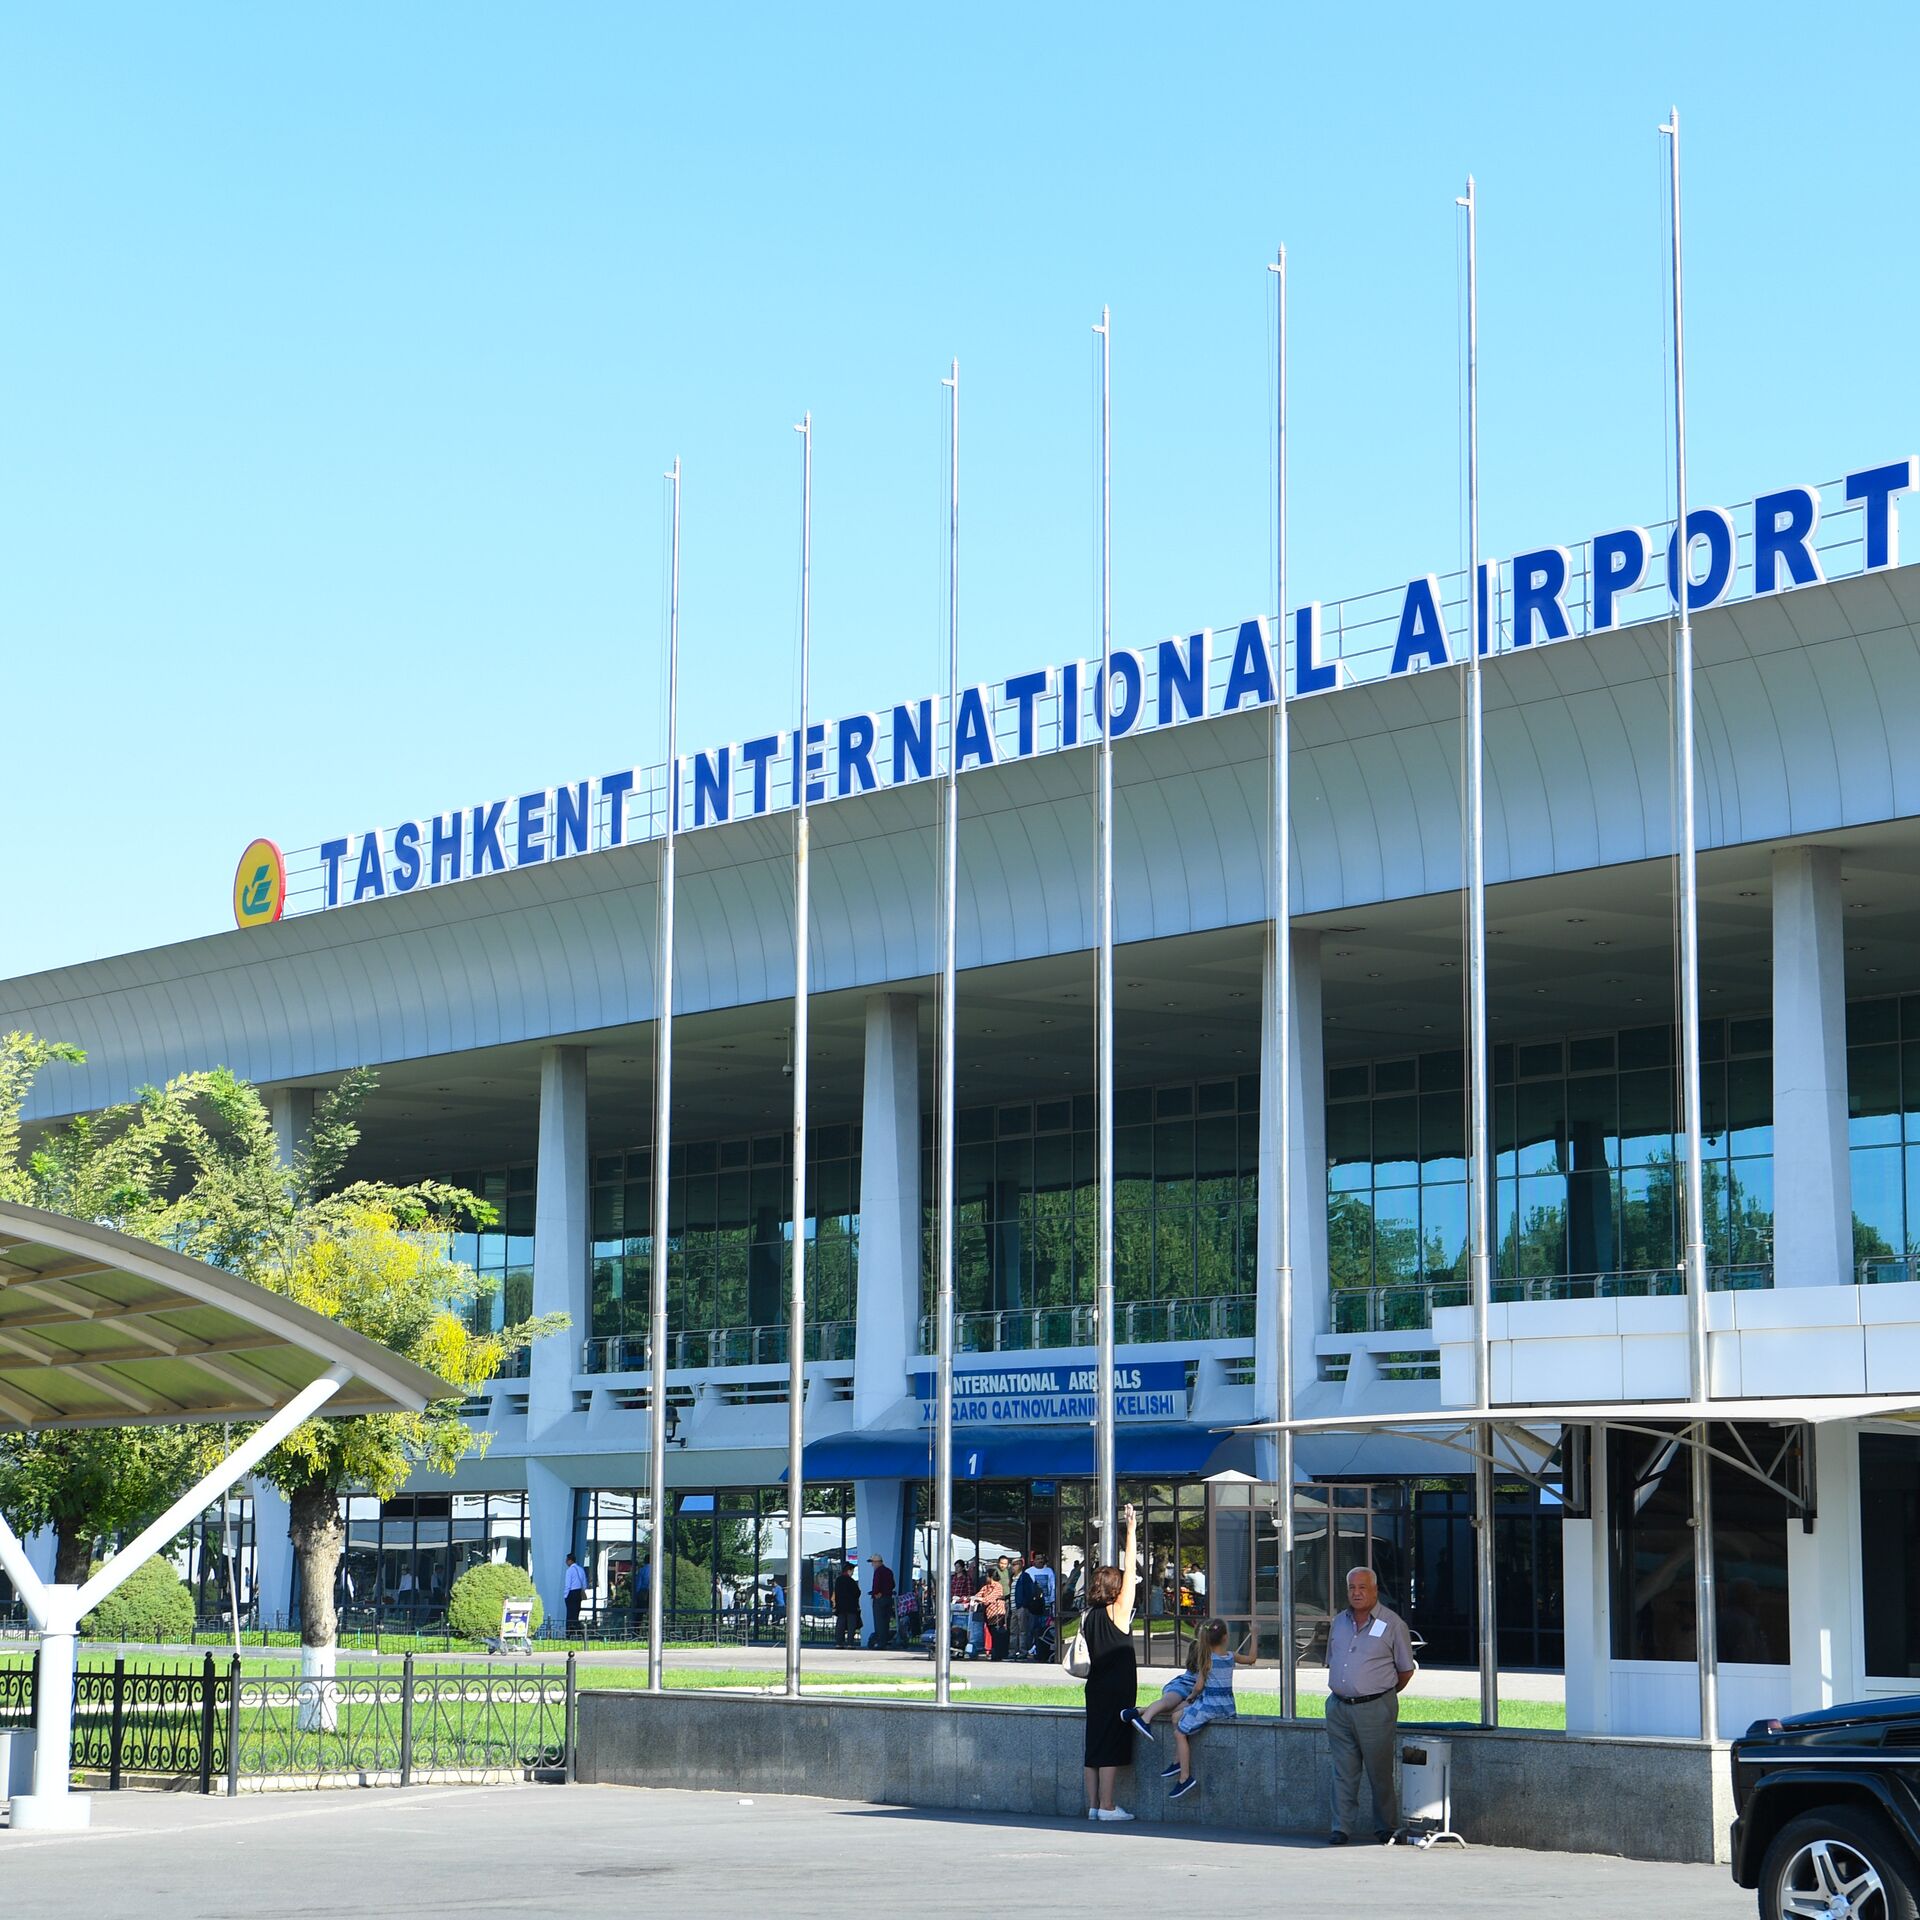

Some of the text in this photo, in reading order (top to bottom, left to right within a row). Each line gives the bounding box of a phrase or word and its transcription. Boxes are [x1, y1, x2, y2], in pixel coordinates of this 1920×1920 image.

[320, 769, 638, 908] TASHKENT
[1388, 458, 1915, 676] AIRPORT
[953, 1369, 1141, 1395] NTERNATIONAL ARRALS
[923, 1395, 1174, 1421] XQARO QATNOVLARNI KELISHI
[968, 1453, 978, 1475] 1
